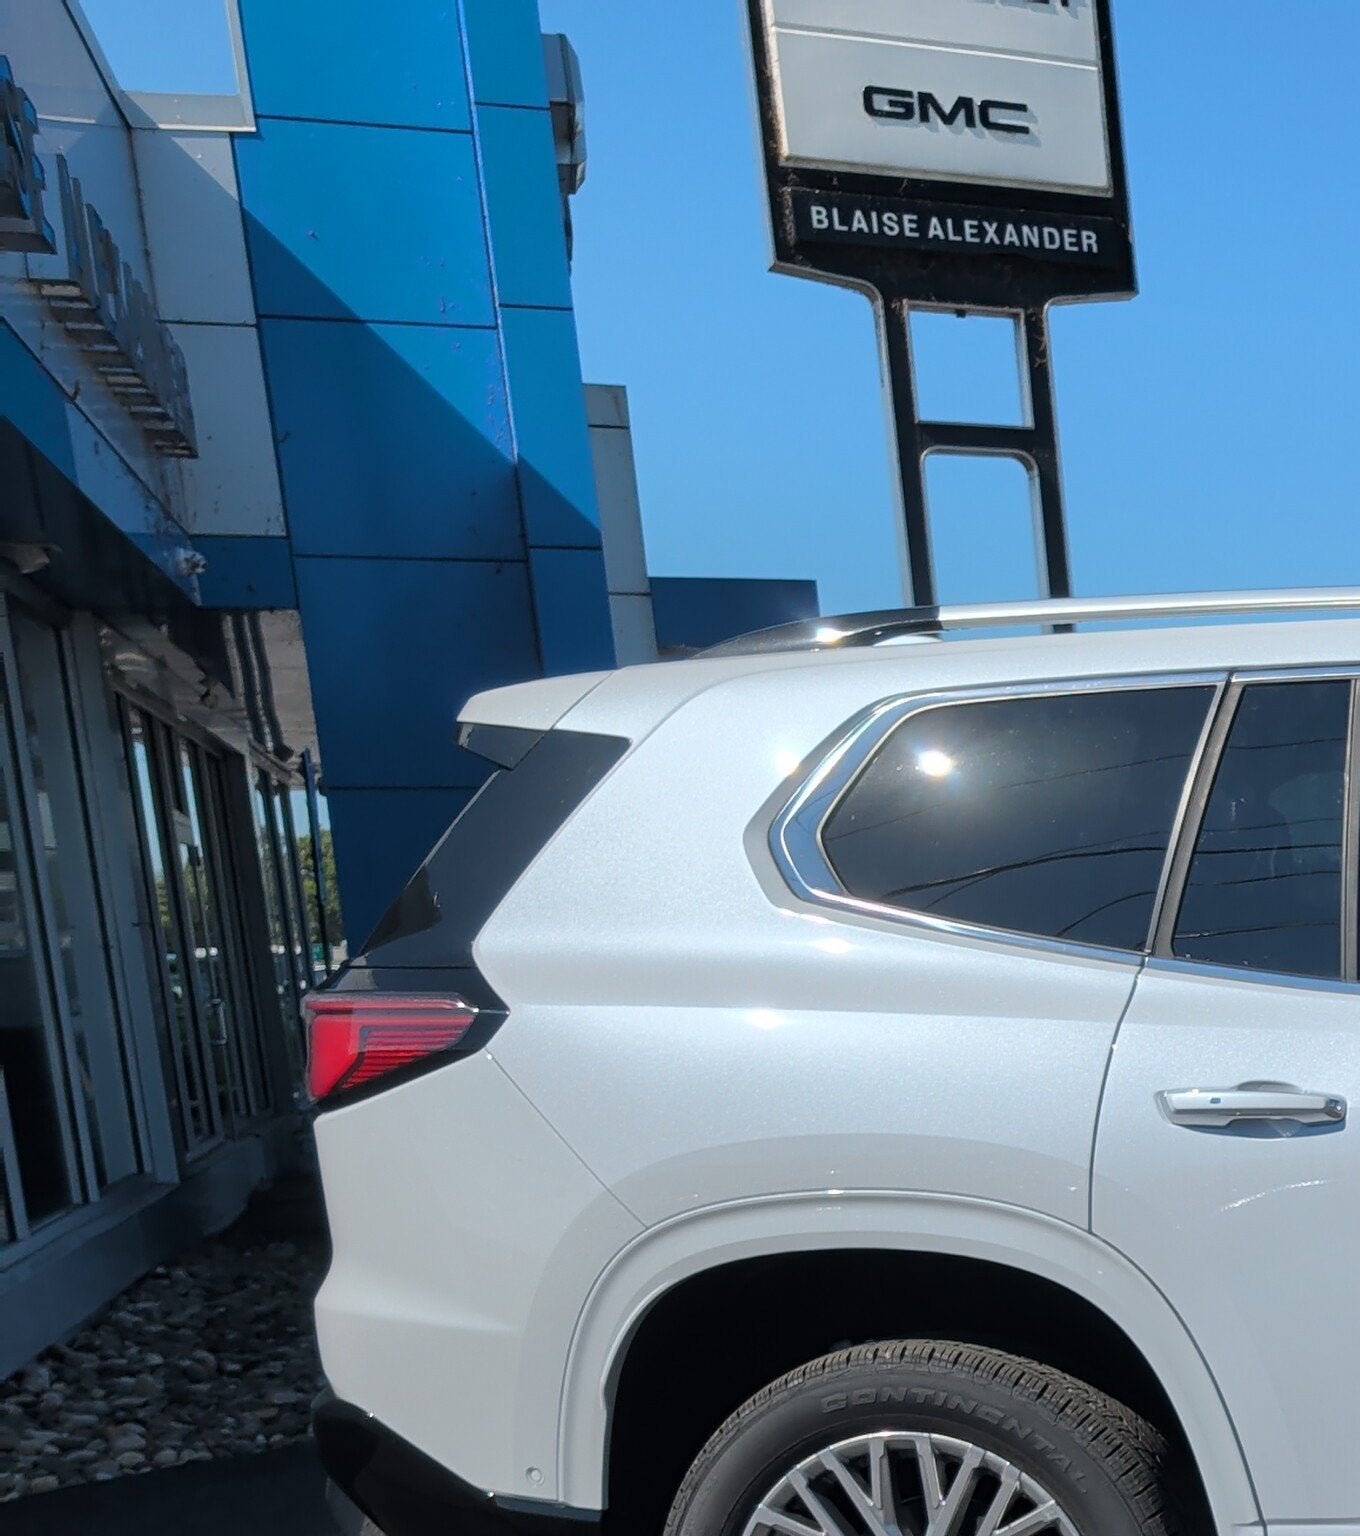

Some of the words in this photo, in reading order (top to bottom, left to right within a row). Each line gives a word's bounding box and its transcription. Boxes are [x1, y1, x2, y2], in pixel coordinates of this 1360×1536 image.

[863, 85, 1030, 135] GMC
[810, 205, 920, 239] BLAISE
[928, 216, 1099, 254] ALEXANDER
[821, 1387, 1088, 1495] CONTINENTAL
